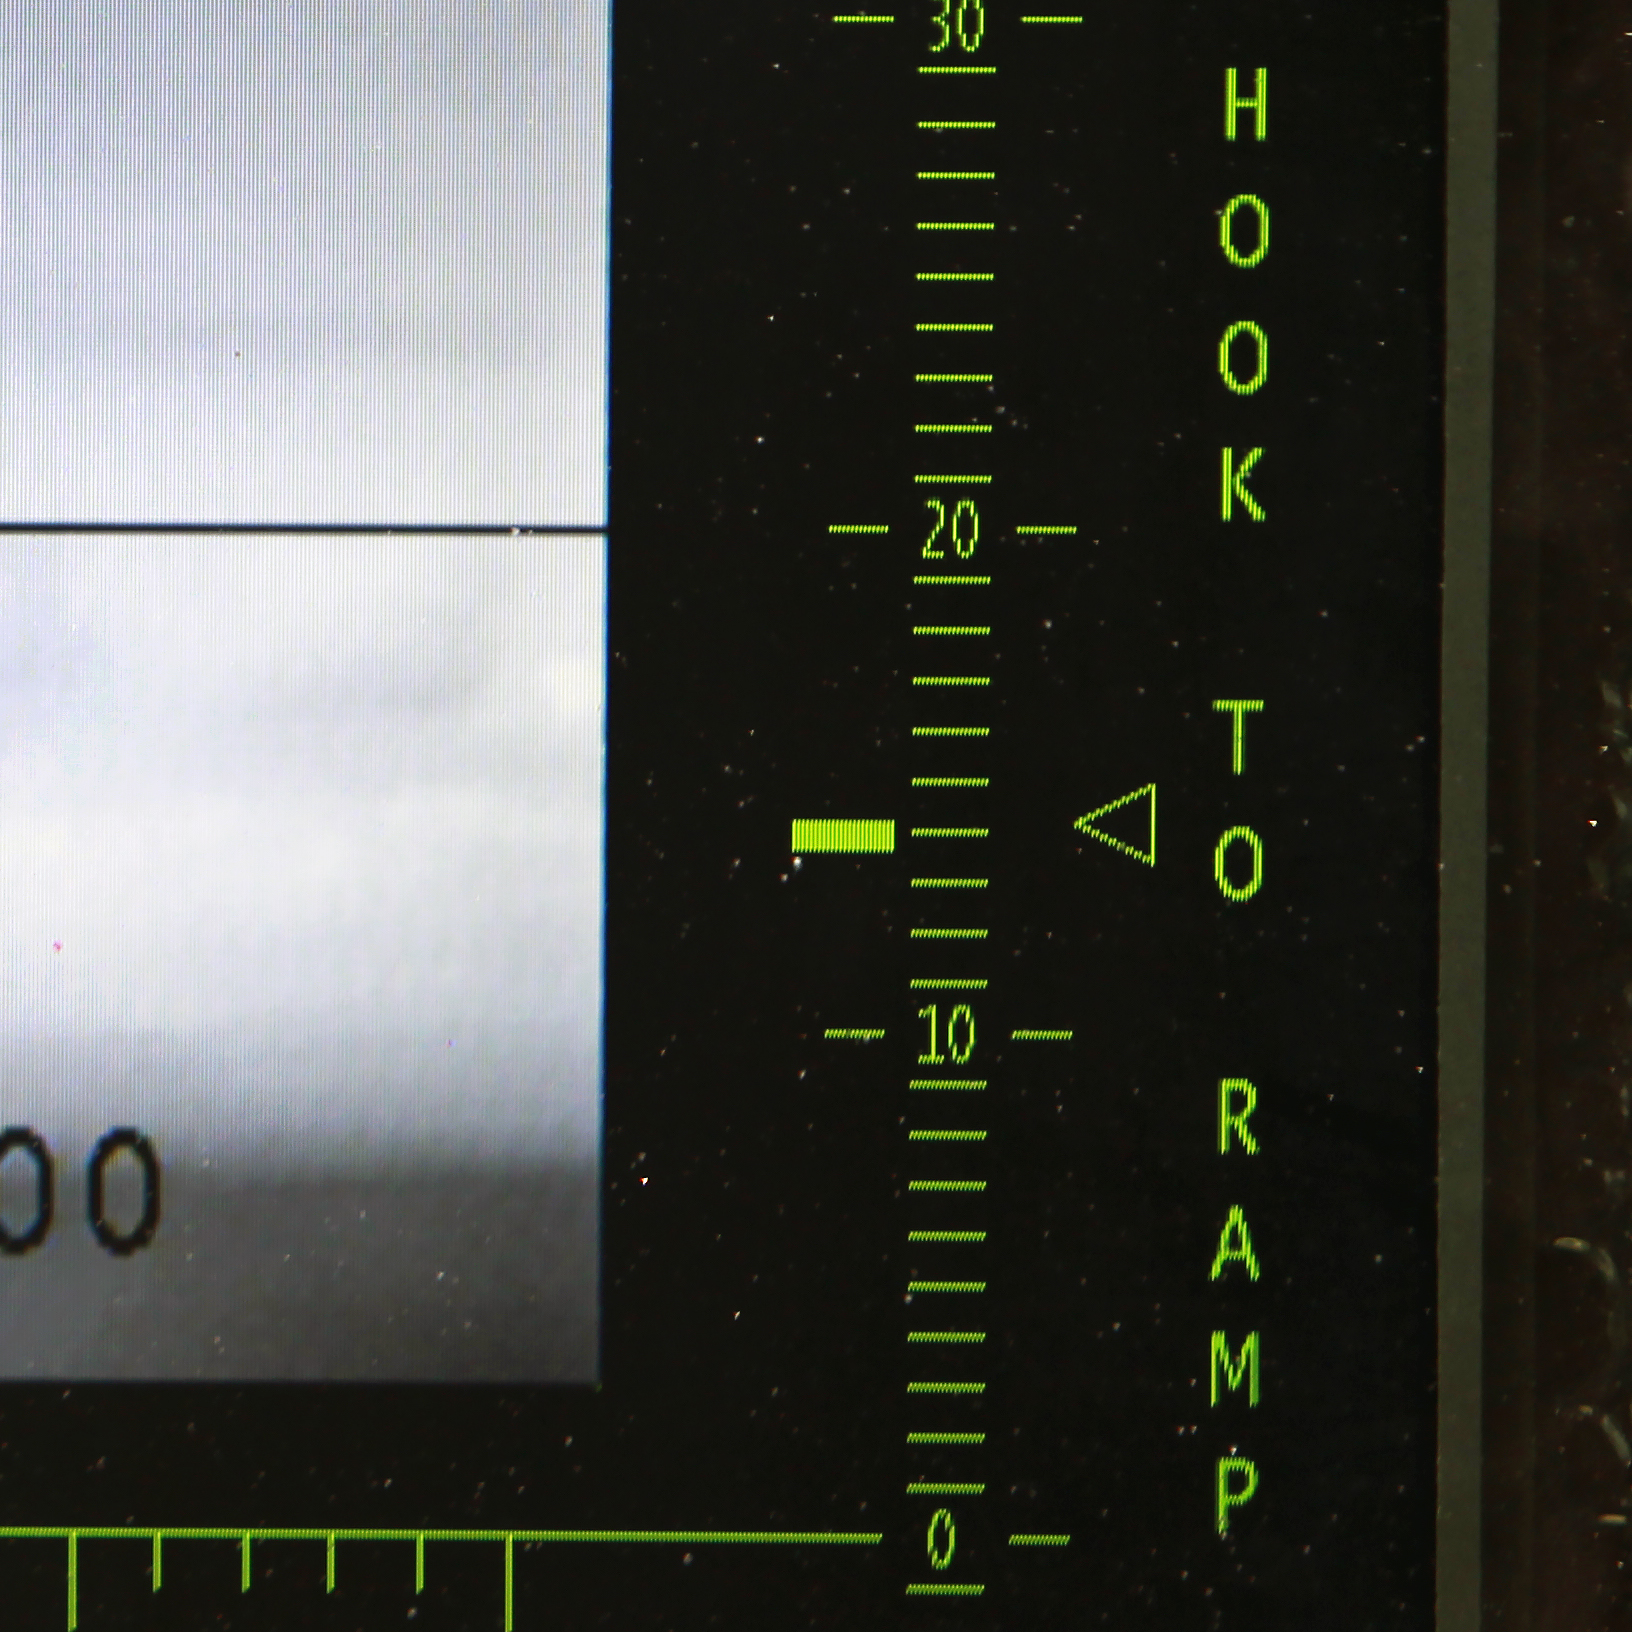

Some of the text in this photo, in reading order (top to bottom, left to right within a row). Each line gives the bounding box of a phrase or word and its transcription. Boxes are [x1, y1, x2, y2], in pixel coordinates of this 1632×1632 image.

[922, 498, 978, 561] 20
[1211, 68, 1269, 1531] HOOK TO RAMP
[918, 1003, 975, 1065] 10
[928, 1506, 955, 1568] 0
